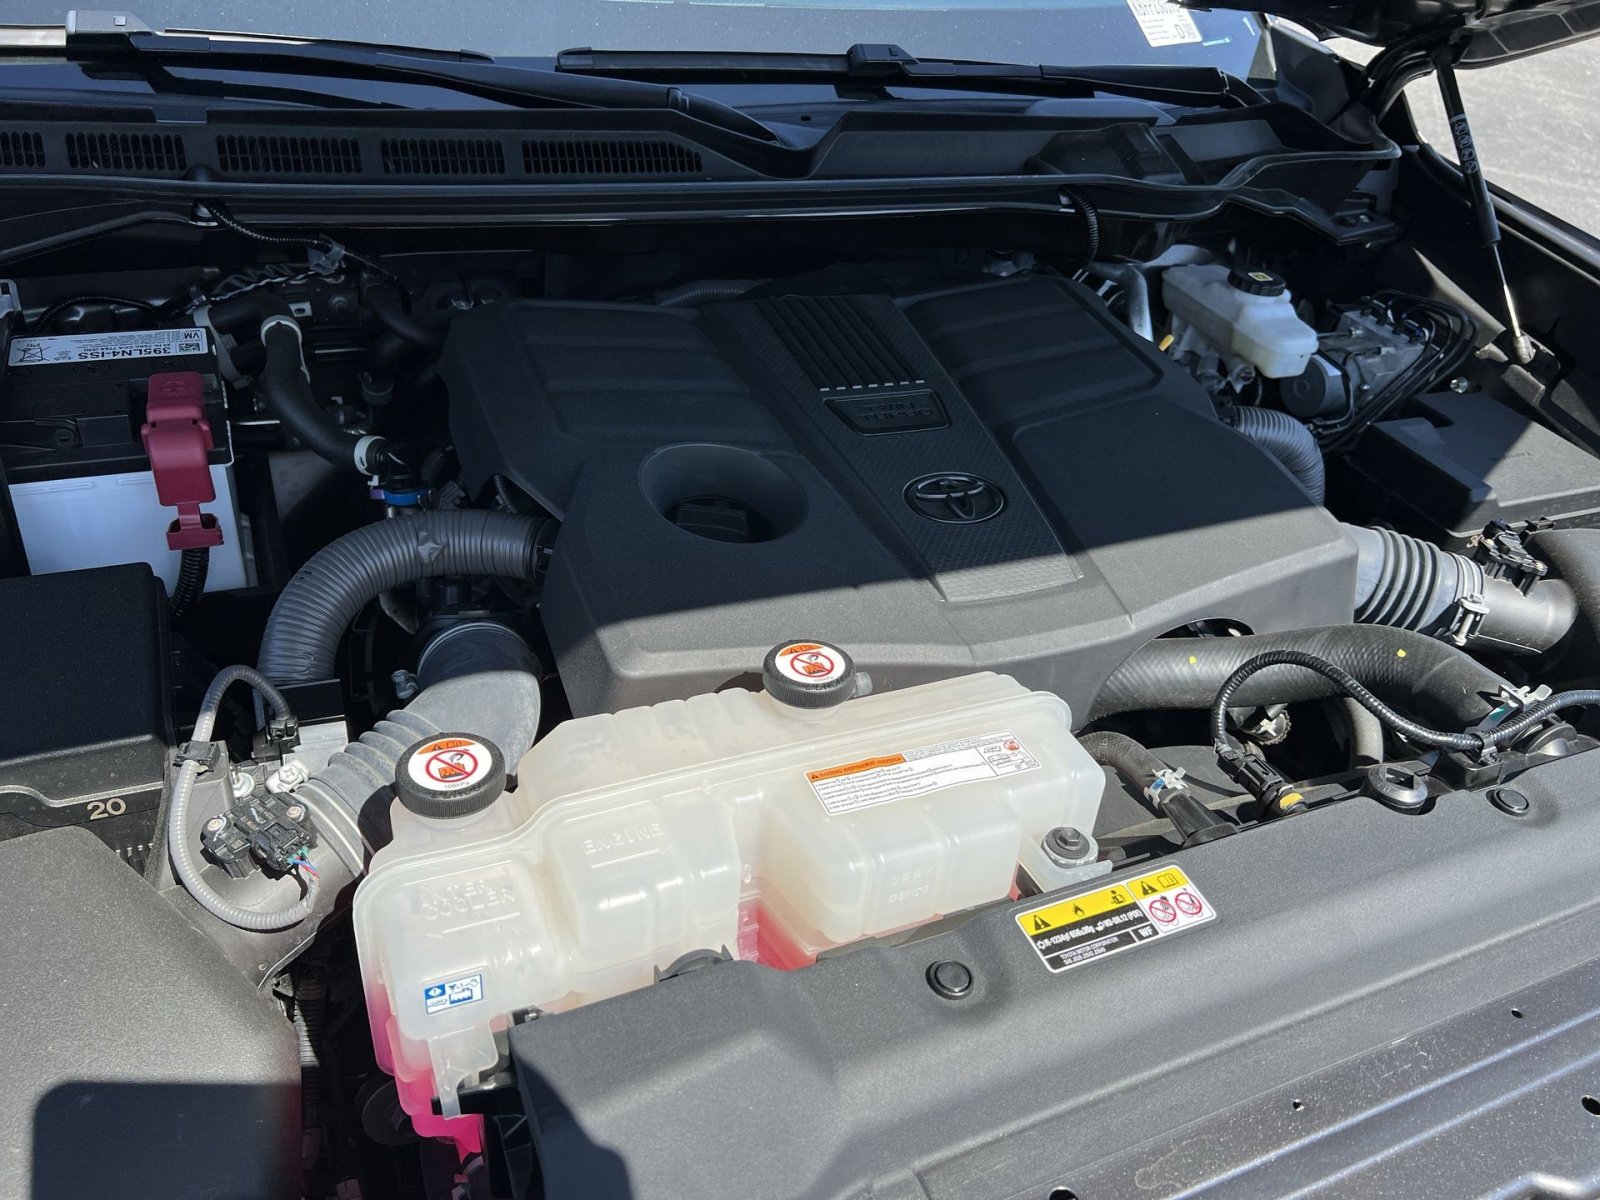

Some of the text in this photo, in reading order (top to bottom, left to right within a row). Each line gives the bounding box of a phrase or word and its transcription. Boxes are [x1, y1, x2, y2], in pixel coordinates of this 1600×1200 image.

[78, 347, 171, 360] 395LN4-ISS
[86, 797, 127, 820] 20
[582, 823, 664, 854] ENGINE
[422, 888, 515, 920] COOLER
[1138, 926, 1154, 938] WF
